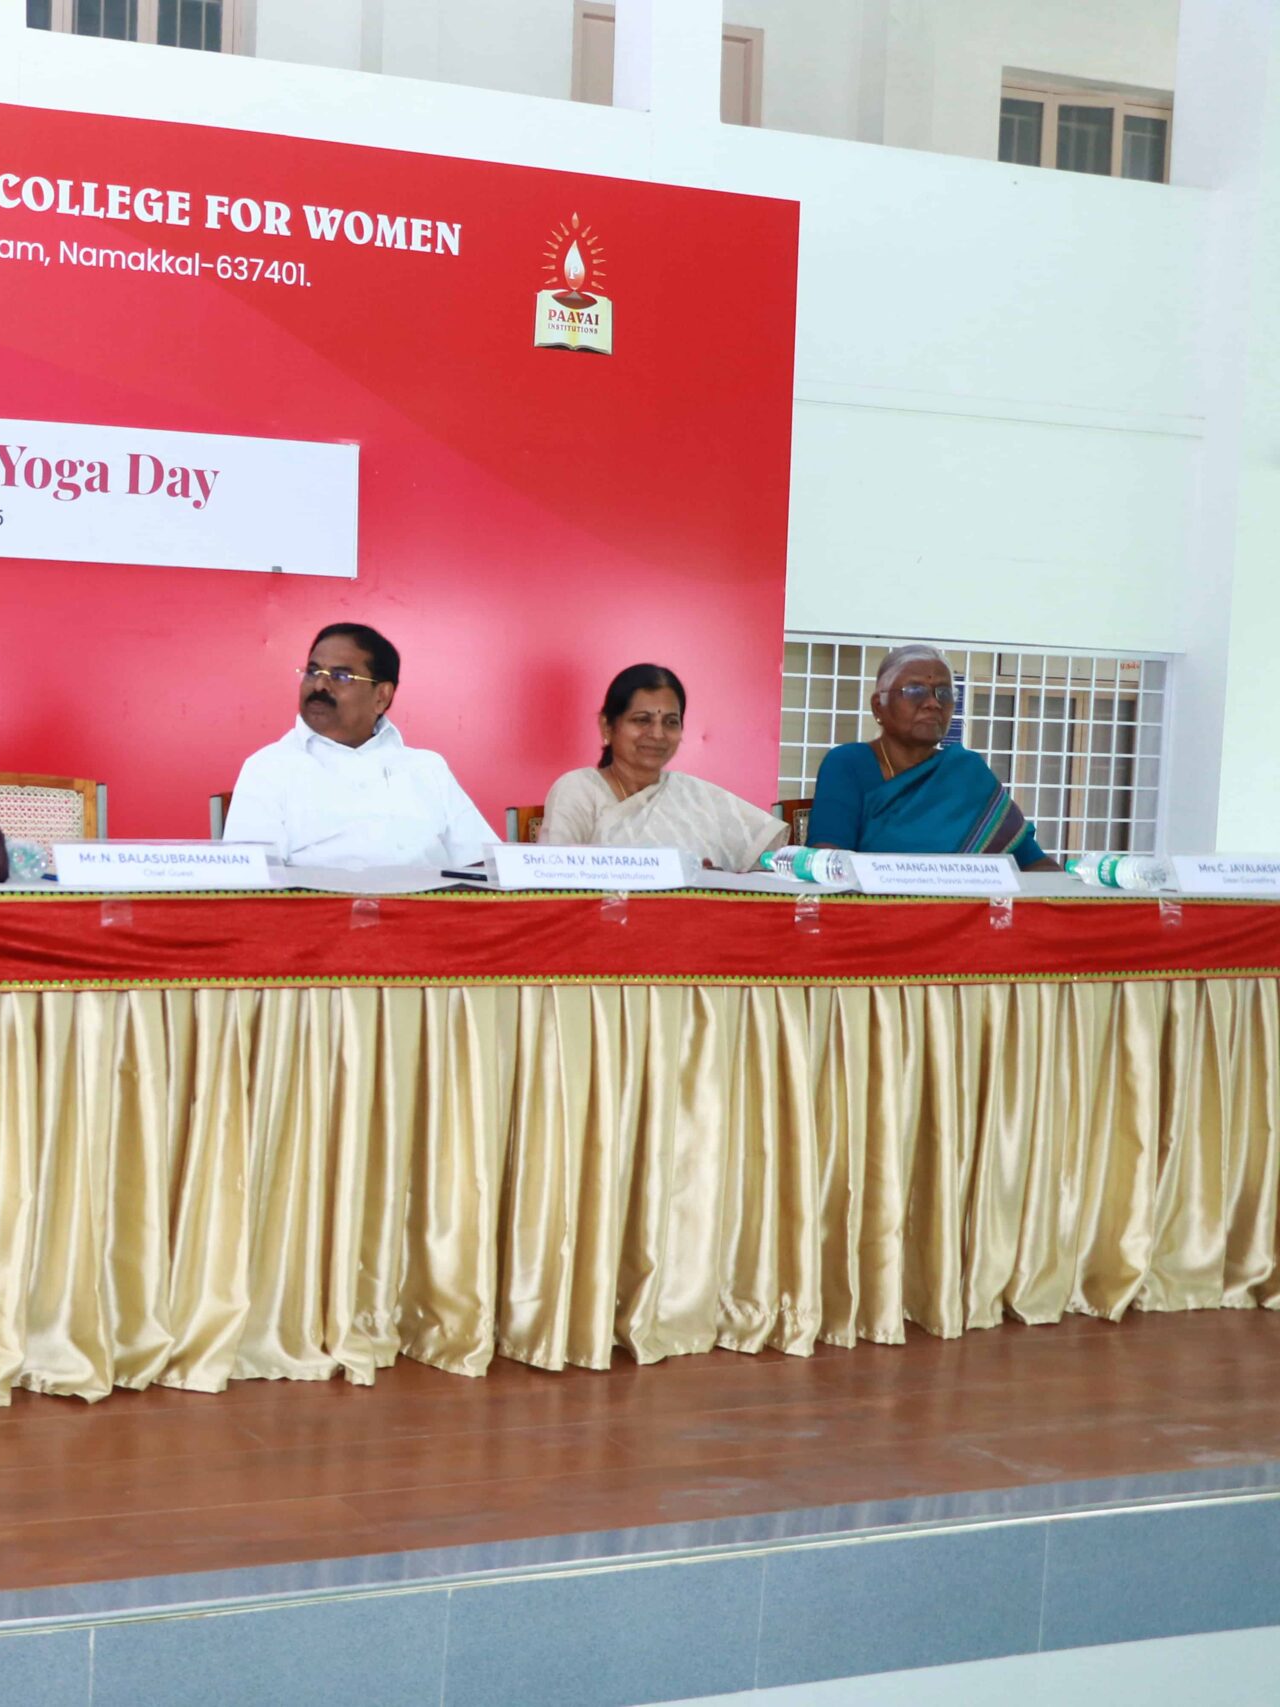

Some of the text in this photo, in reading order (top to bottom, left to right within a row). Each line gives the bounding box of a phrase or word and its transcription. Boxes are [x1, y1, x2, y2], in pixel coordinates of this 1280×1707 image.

[205, 195, 292, 238] FOR
[303, 206, 462, 257] WOMEN
[59, 240, 312, 288] Namakkal-637401.
[548, 309, 600, 326] PAAVAI
[547, 323, 598, 334] INSTITUTIONS
[125, 452, 220, 510] Day
[119, 853, 251, 865] BALASUBRAMANIAN
[591, 855, 660, 867] NATARAJAN
[895, 863, 938, 873] MANGAI
[939, 864, 1000, 874] NATARAJAN
